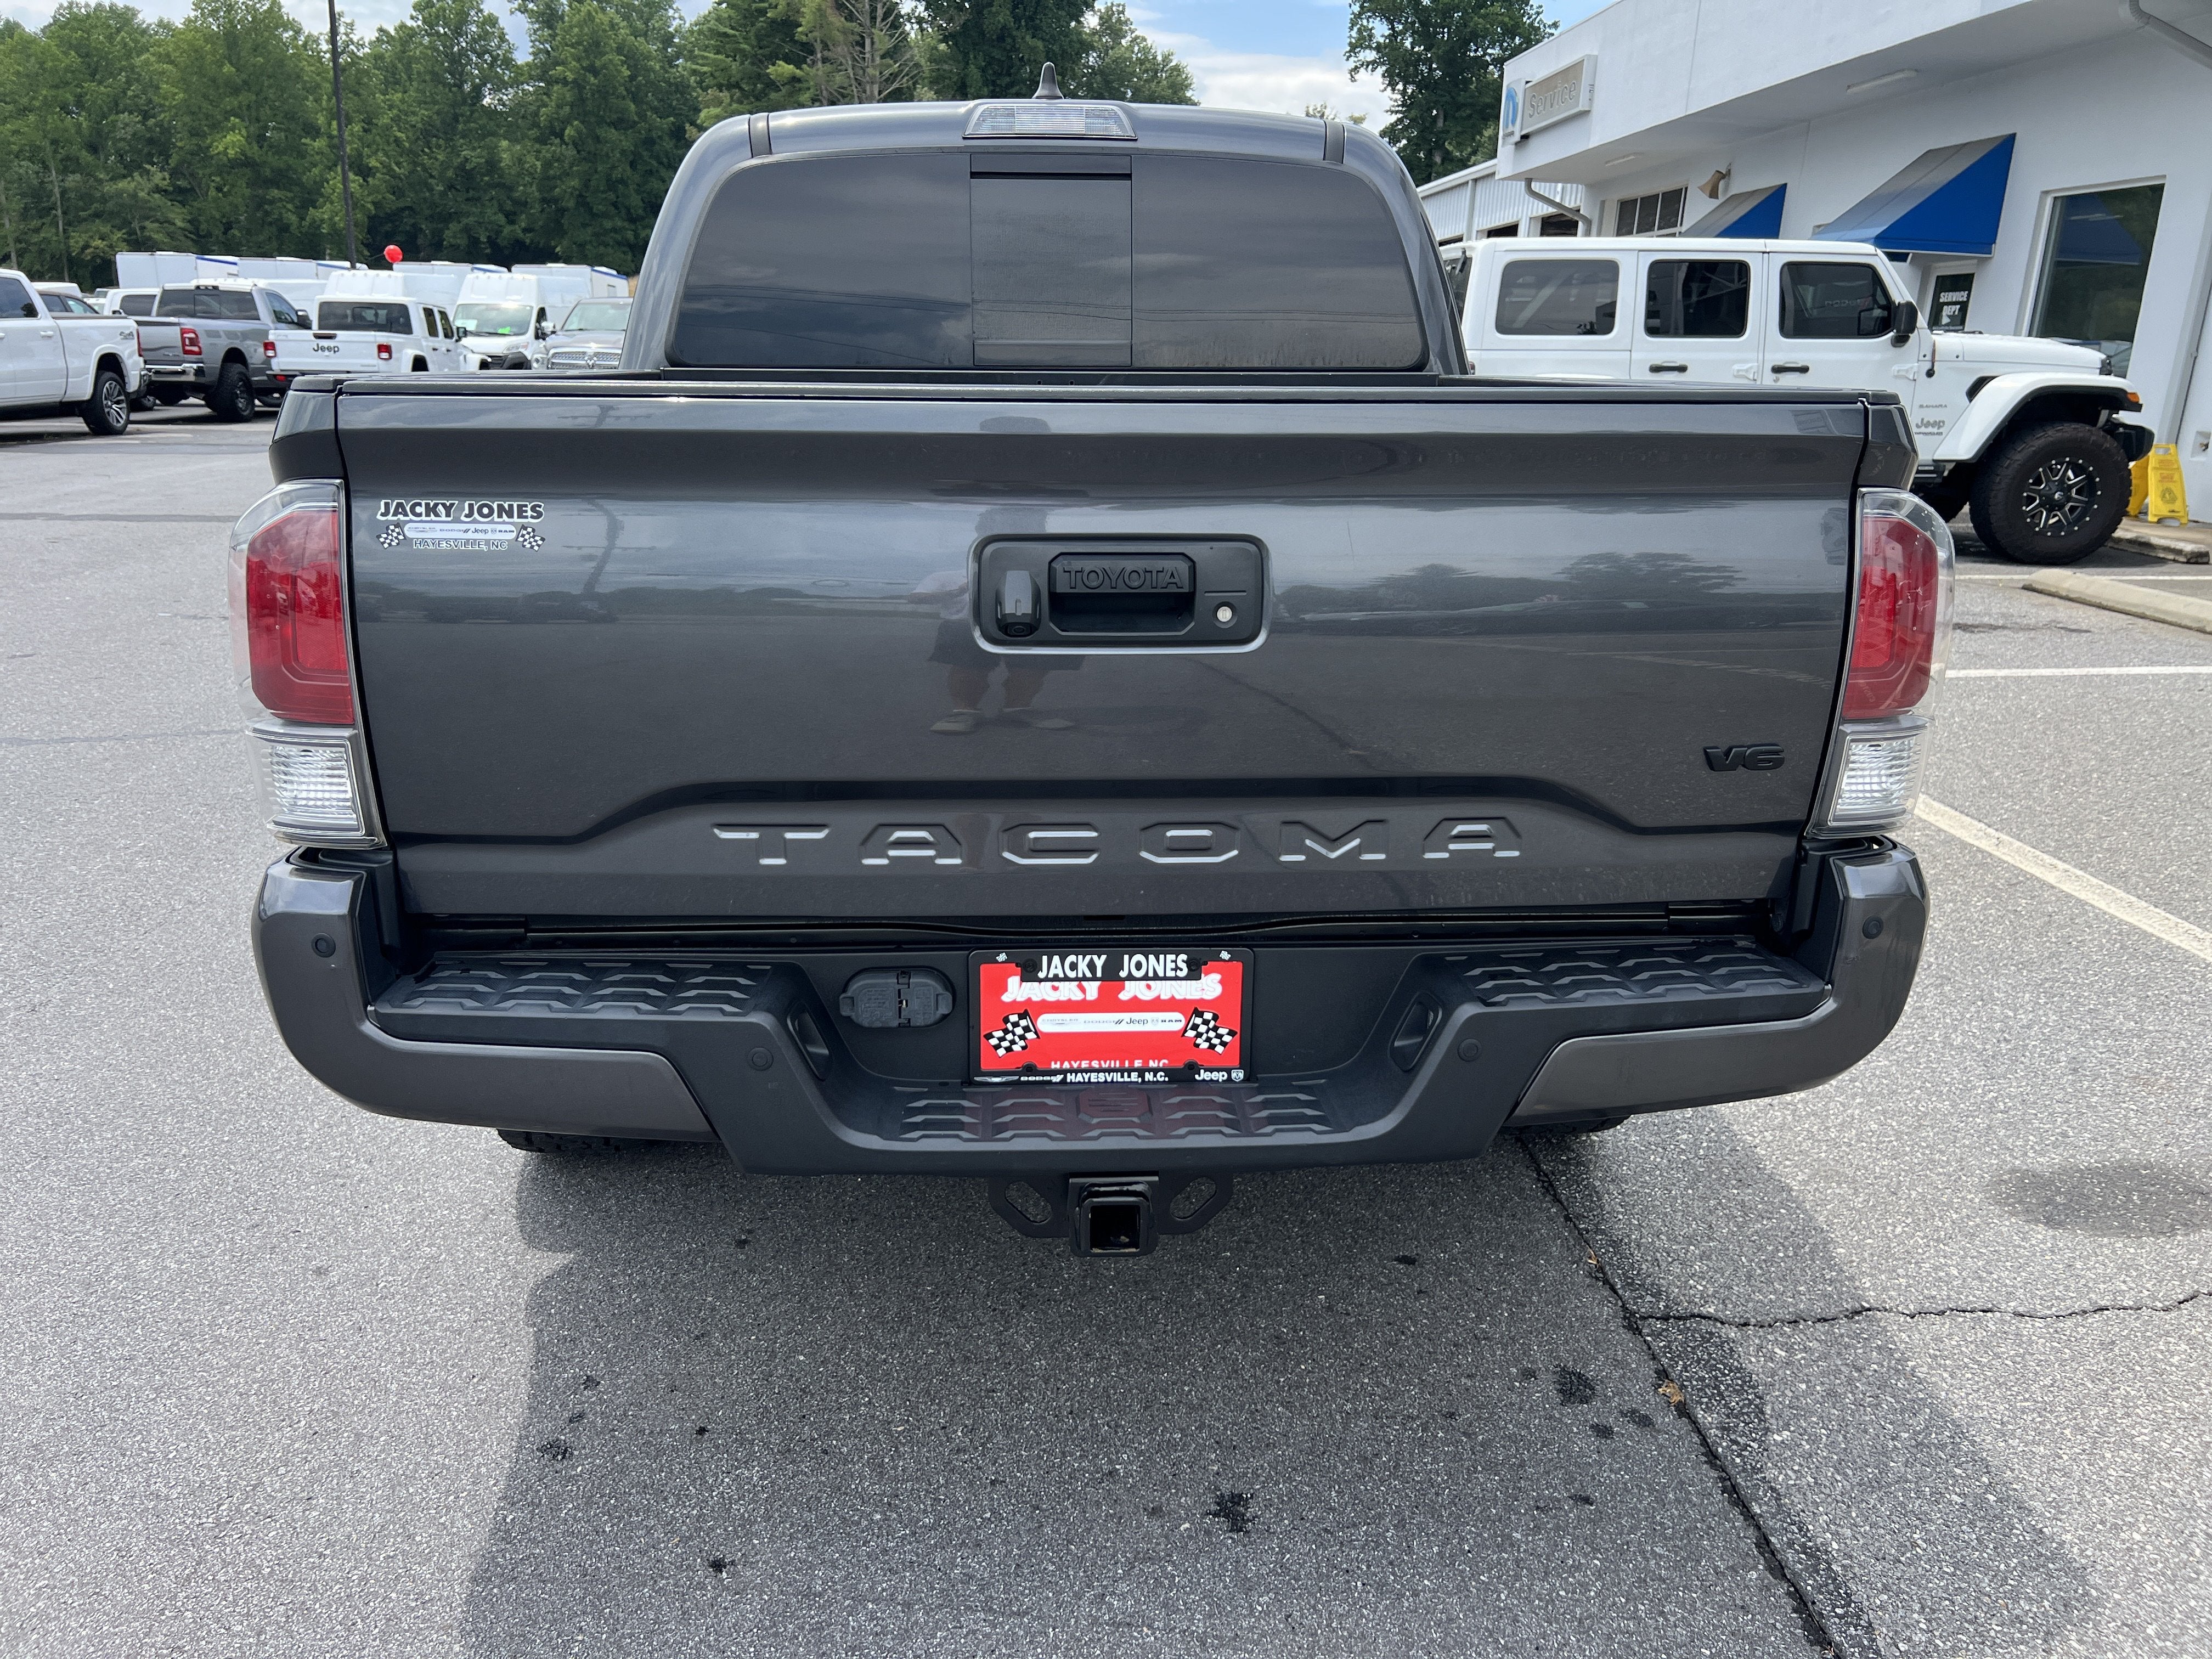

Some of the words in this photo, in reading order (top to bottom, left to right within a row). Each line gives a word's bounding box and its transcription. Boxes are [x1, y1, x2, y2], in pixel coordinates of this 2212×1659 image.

[1528, 80, 1577, 119] Service
[1939, 291, 1968, 302] SERVICE
[1942, 304, 1961, 315] DEPT
[312, 342, 340, 354] Jeep
[1915, 417, 1945, 430] Jeep
[376, 500, 458, 521] JACKY
[460, 501, 544, 522] JONES
[413, 539, 488, 551] HAYESVILLE,
[490, 540, 508, 550] NC
[1063, 566, 1184, 590] TOYOTA
[1703, 743, 1785, 772] V6
[712, 817, 1522, 866] TACOMA
[1037, 954, 1107, 978] JACKY
[1119, 953, 1188, 978] JONES
[1001, 975, 1102, 1002] JACKY
[1118, 973, 1223, 1001] JONES
[1126, 1017, 1148, 1025] Jeep
[1149, 1059, 1169, 1068] NC
[1066, 1071, 1142, 1084] HAYESVILLE,
[1144, 1071, 1169, 1082] N.C.
[1194, 1069, 1228, 1082] Jeep
